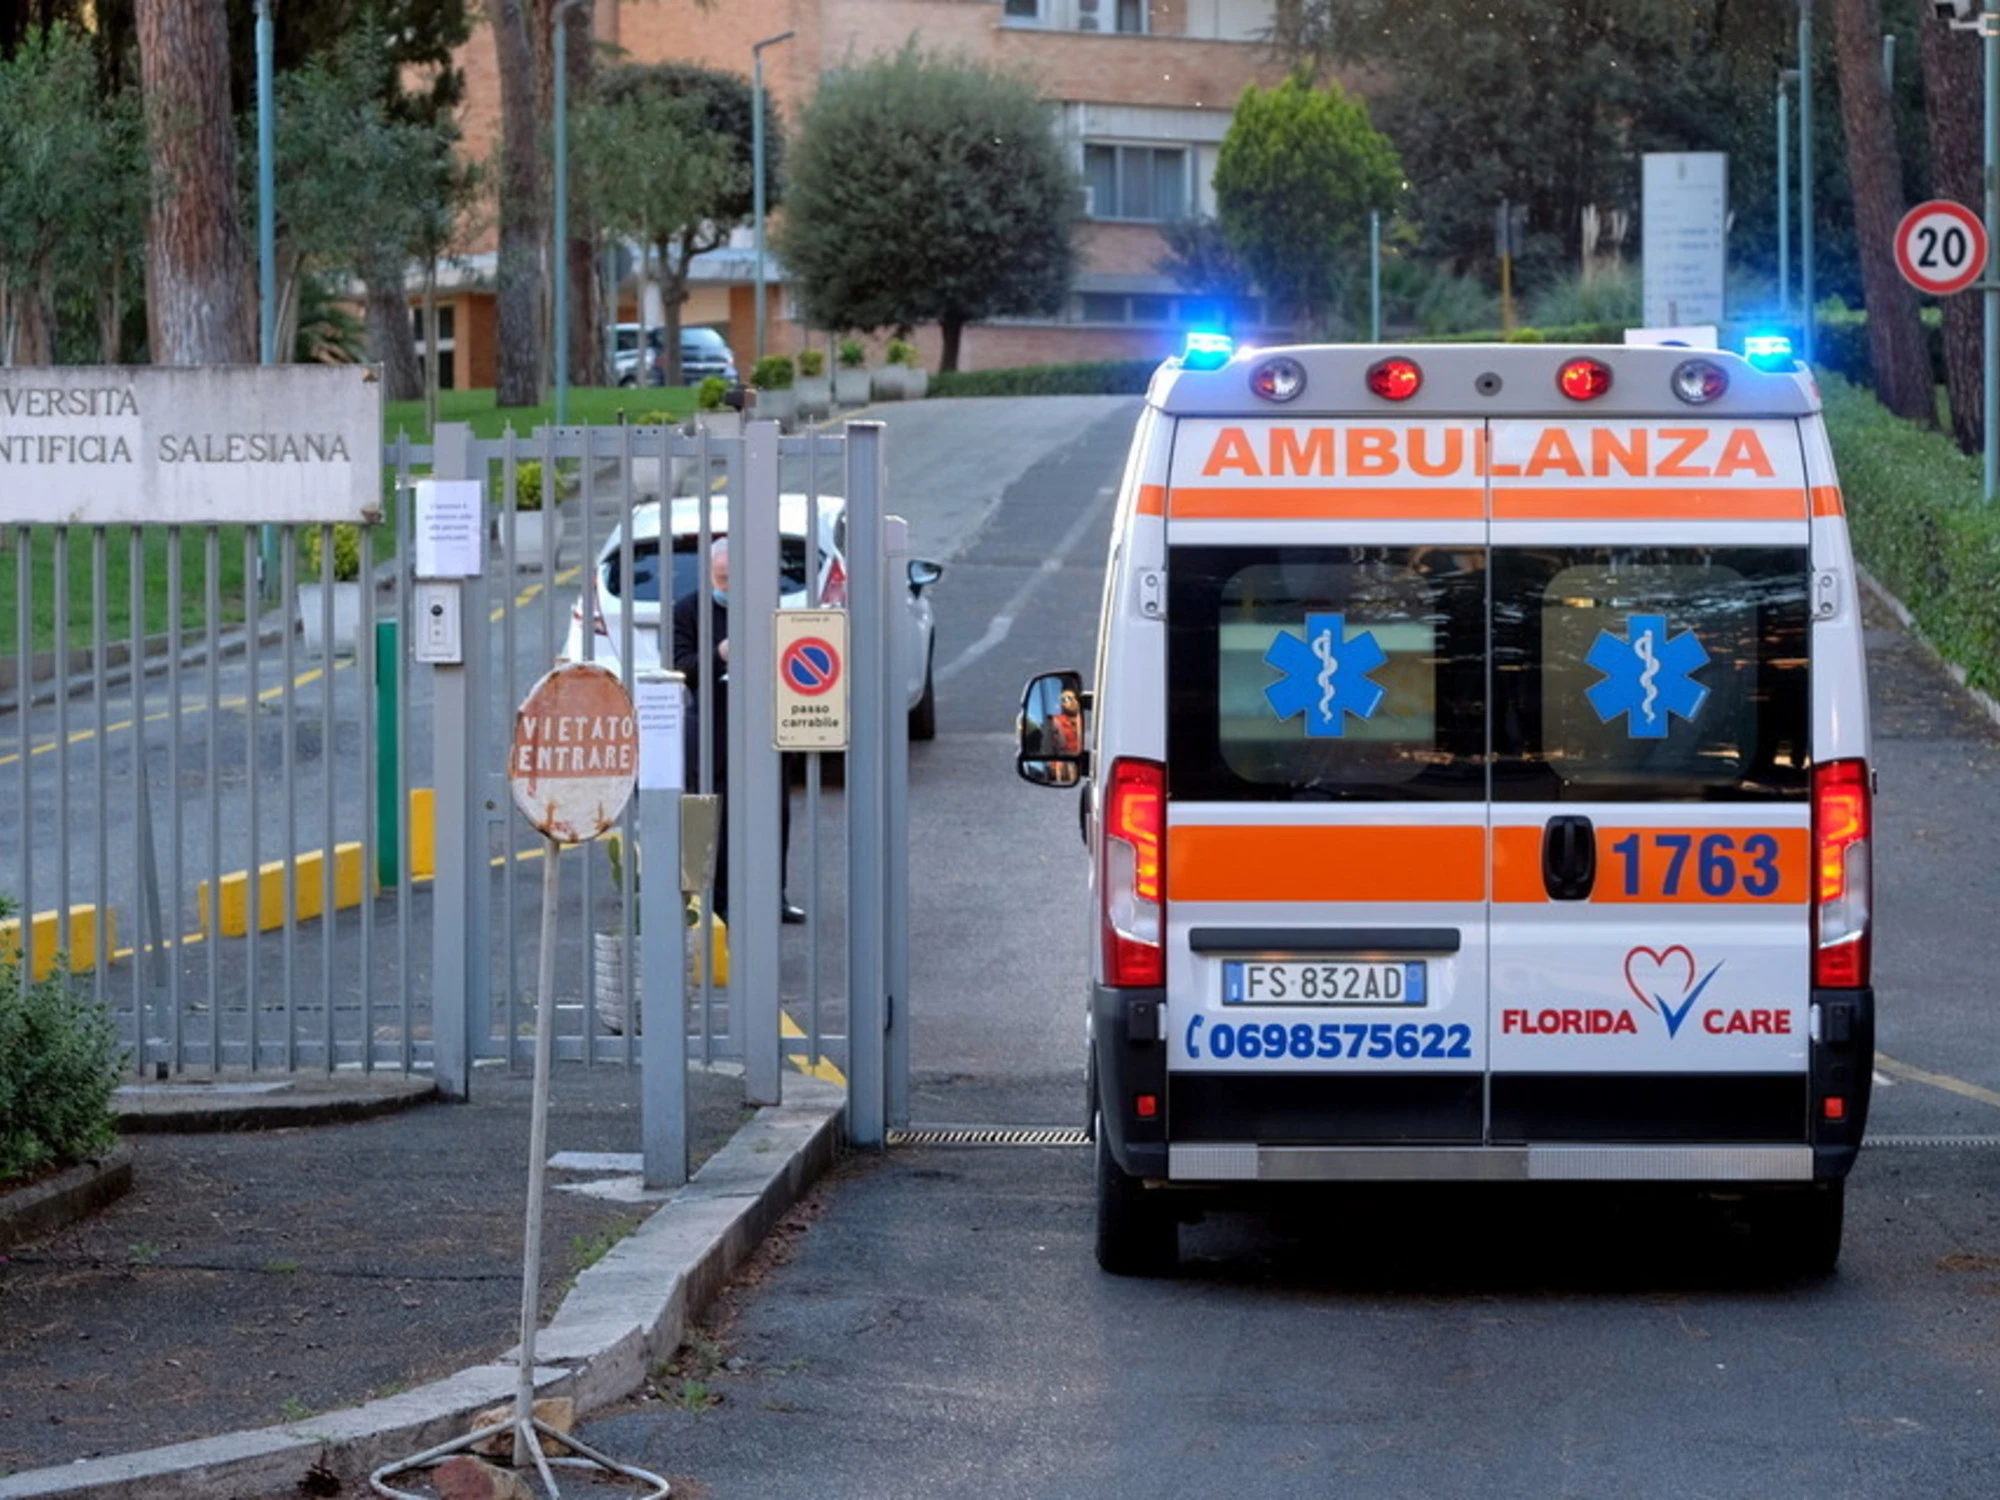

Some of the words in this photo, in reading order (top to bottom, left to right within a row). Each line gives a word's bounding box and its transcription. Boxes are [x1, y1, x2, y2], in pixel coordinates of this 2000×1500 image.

[1917, 227, 1967, 268] 20
[158, 433, 351, 463] SALESIANA
[1201, 427, 1776, 478] AMBULANZA
[781, 716, 839, 728] carrabile
[791, 705, 830, 715] passo
[522, 716, 633, 741] VIETATO
[518, 744, 631, 771] ENTRARE
[1612, 833, 1780, 897] 1763
[1299, 966, 1402, 998] 832AD
[1502, 1008, 1638, 1035] FLORIDA
[1702, 1008, 1792, 1035] CARE
[1209, 1022, 1472, 1059] 0698575622
